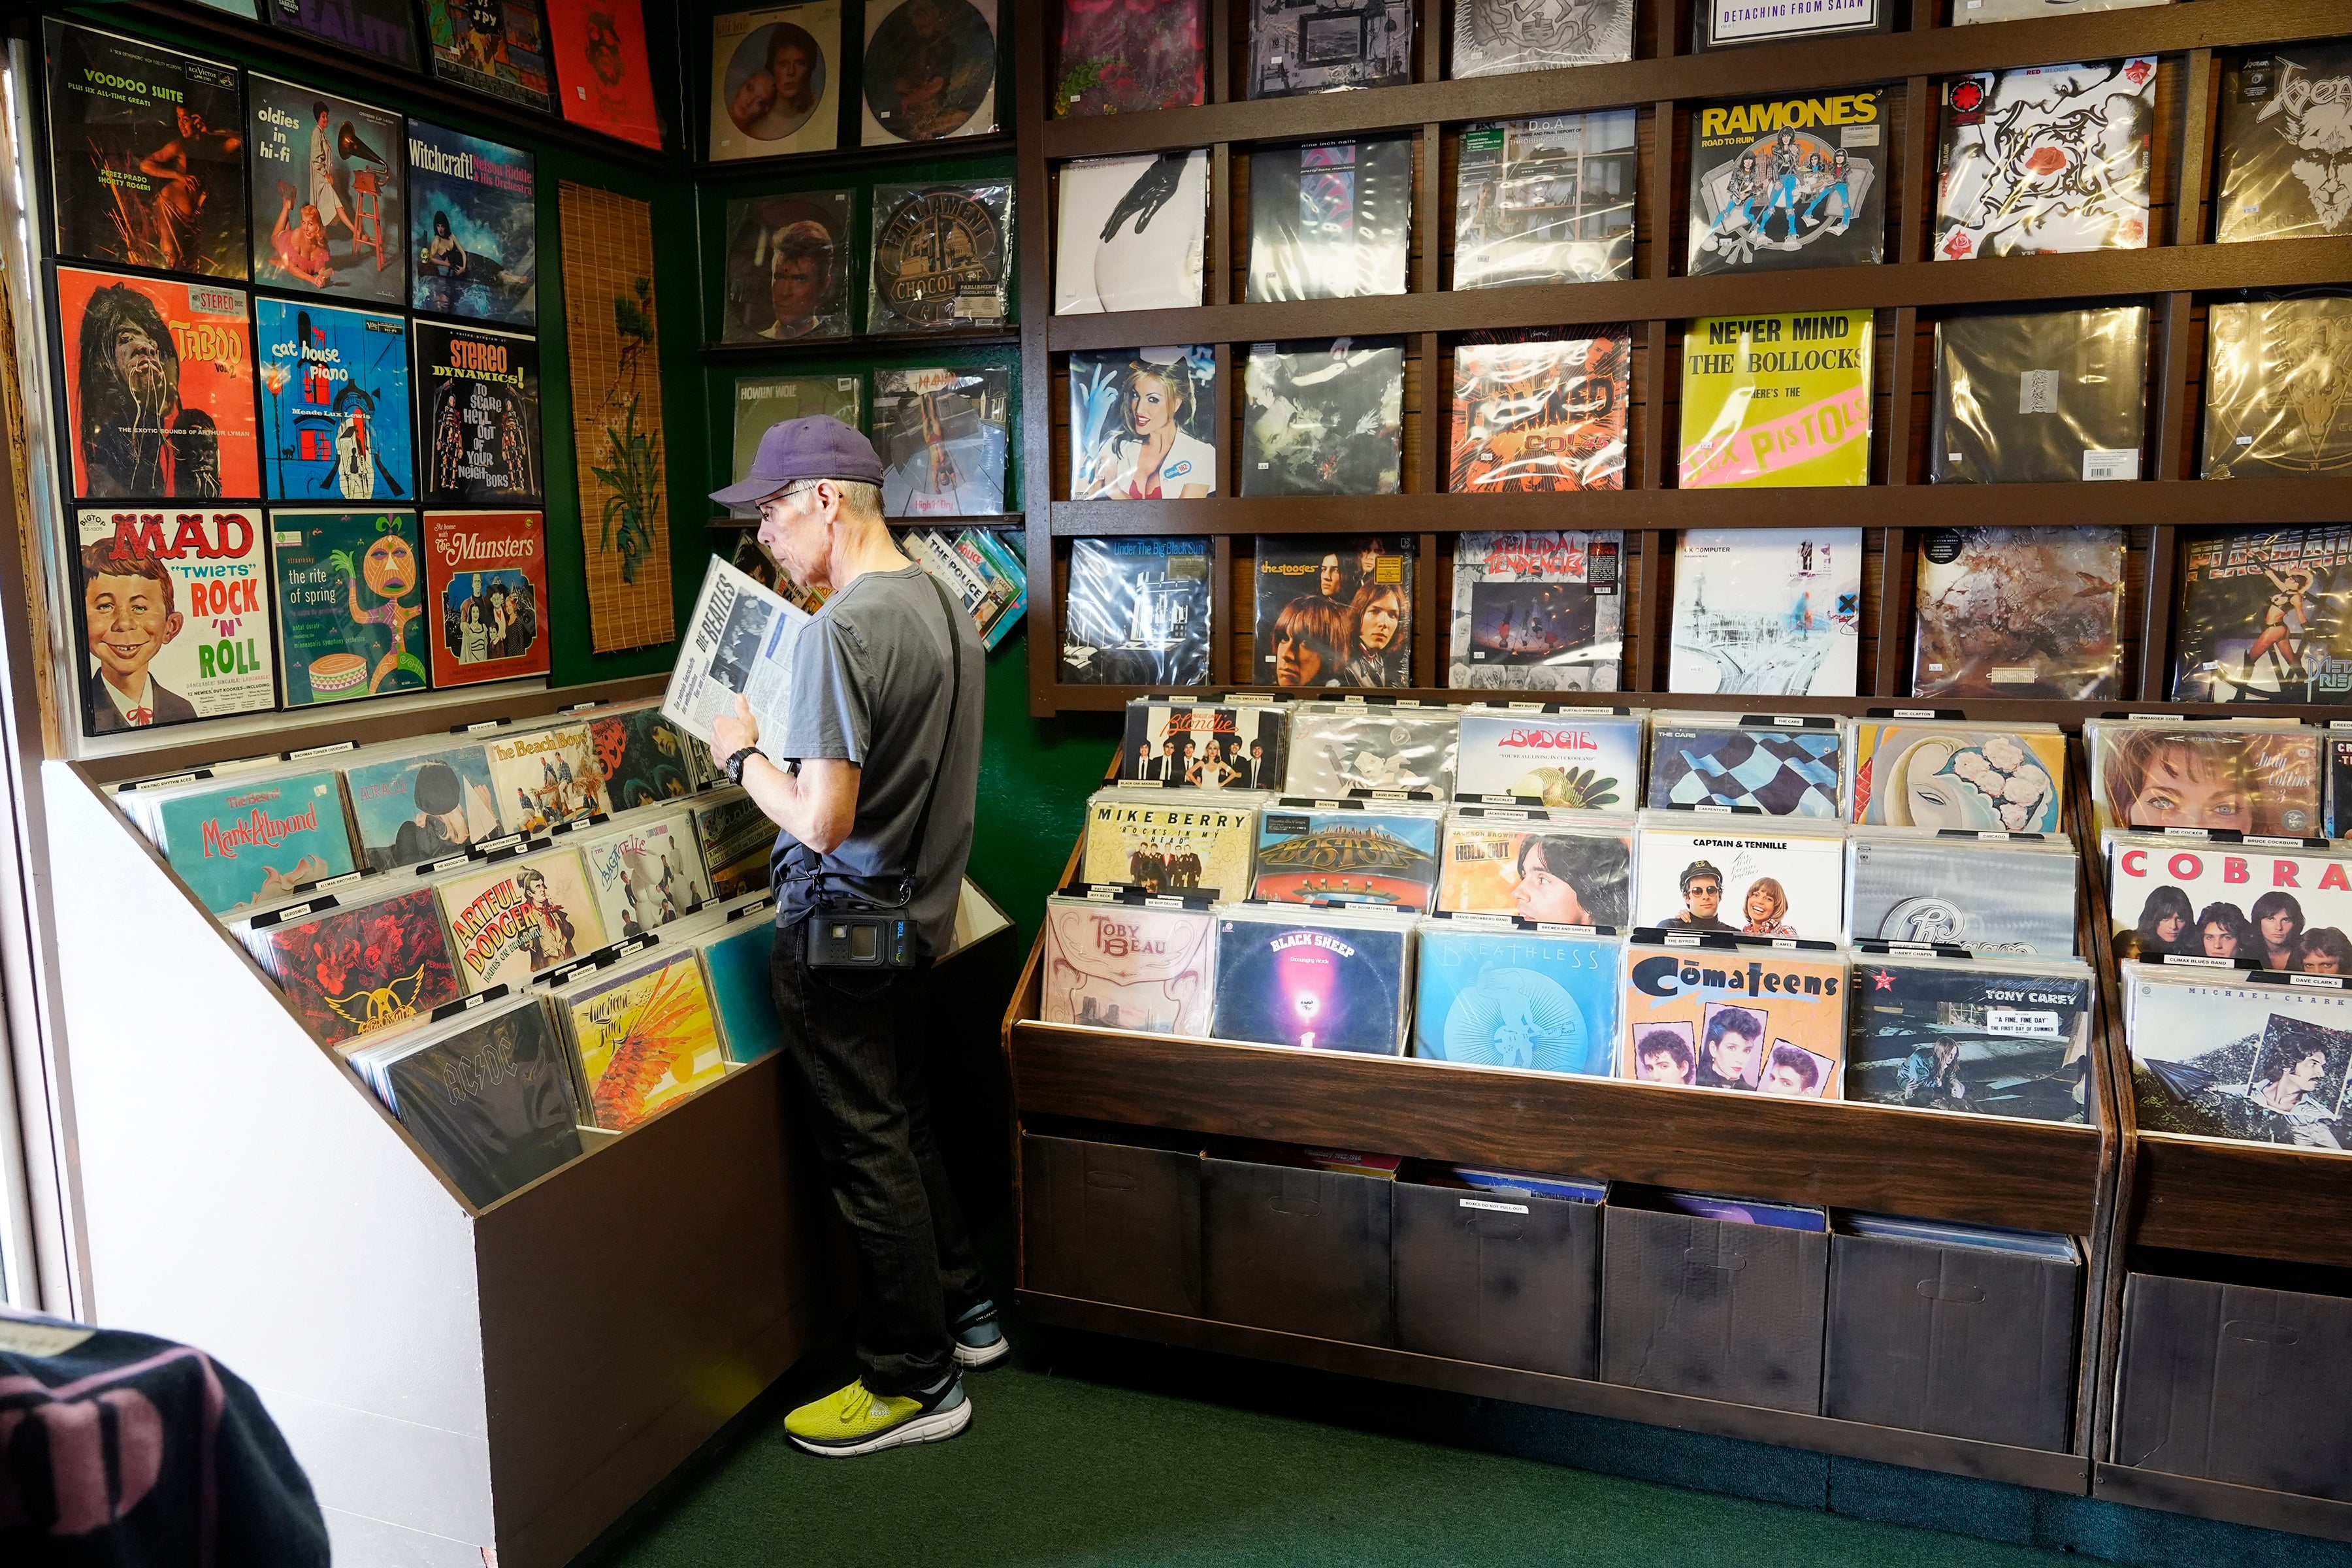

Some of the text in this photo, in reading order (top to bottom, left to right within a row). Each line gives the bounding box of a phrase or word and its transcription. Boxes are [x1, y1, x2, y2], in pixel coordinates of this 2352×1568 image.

[1724, 5, 1786, 24] DETACHING
[1791, 1, 1823, 15] FROM
[68, 82, 151, 106] PLUS SIX ALL-TIME GREATS
[84, 68, 184, 103] VOODOO SUITE
[258, 107, 300, 130] oldies
[1702, 93, 1878, 137] RAMONES
[273, 127, 286, 144] in
[1509, 136, 1551, 146] THROBBING
[1701, 139, 1723, 148] ROAD
[1735, 136, 1755, 144] RUIN
[259, 141, 290, 163] hi-fi
[409, 138, 474, 180] Witchcraft!
[101, 169, 148, 183] PEREZ PRADO
[473, 155, 532, 184] Nelson Riddle
[885, 193, 993, 247] PARLIAMENT
[1709, 316, 1849, 345] NEVER MIND
[169, 319, 242, 365] TABOO
[272, 340, 340, 363] cat house
[1688, 347, 1862, 375] THE BOLLOCKS
[310, 363, 348, 382] piano
[431, 365, 524, 389] DYNAMICS!
[476, 383, 487, 396] TO
[740, 384, 797, 400] HOWLIN' WOLF
[1750, 387, 1801, 399] HERE'S THE
[477, 425, 497, 440] OUT
[474, 438, 485, 452] OF
[466, 450, 494, 466] YOUR
[485, 474, 509, 488] BORS
[109, 514, 254, 560] MAD
[1491, 534, 1582, 556] SUICIDAL
[434, 532, 534, 566] The Munsters
[1113, 542, 1203, 558] Under The Big Black Sun
[930, 538, 982, 599] THE POLICE
[1486, 551, 1585, 576] TENDENCIES
[289, 569, 327, 585] the rite
[191, 579, 259, 617] ROCK
[290, 587, 336, 605] of spring
[703, 572, 736, 646] BEATLES
[695, 636, 710, 654] DIE
[199, 638, 260, 679] ROLL
[1160, 713, 1239, 737] Blondie
[327, 745, 348, 753] OVERDRIVE
[514, 730, 588, 758] Beach Boys
[1498, 728, 1598, 750] BUDGIE
[2255, 751, 2287, 770] Judy
[2269, 770, 2311, 788] Collins
[227, 788, 282, 808] The Best of
[1098, 808, 1247, 829] MIKE BERRY
[202, 802, 318, 858] Mark-Almond
[1456, 842, 1509, 860] HOLD OUT
[1693, 838, 1787, 850] CAPTAIN & TENNILLE
[444, 858, 466, 868] ASSOCIATION
[2121, 851, 2352, 892] COBRA
[284, 907, 308, 917] AEROSMITH
[453, 878, 523, 948] ARTFUL
[1090, 915, 1141, 941] TOBY
[464, 902, 539, 977] DODGER
[1103, 938, 1166, 955] BEAU
[1269, 934, 1356, 959] BLACK SHEEP
[1441, 939, 1599, 970] BREATHLESS
[1985, 990, 2078, 1006] TONY CAREY
[2189, 988, 2347, 1007] MICHAEL CLARK
